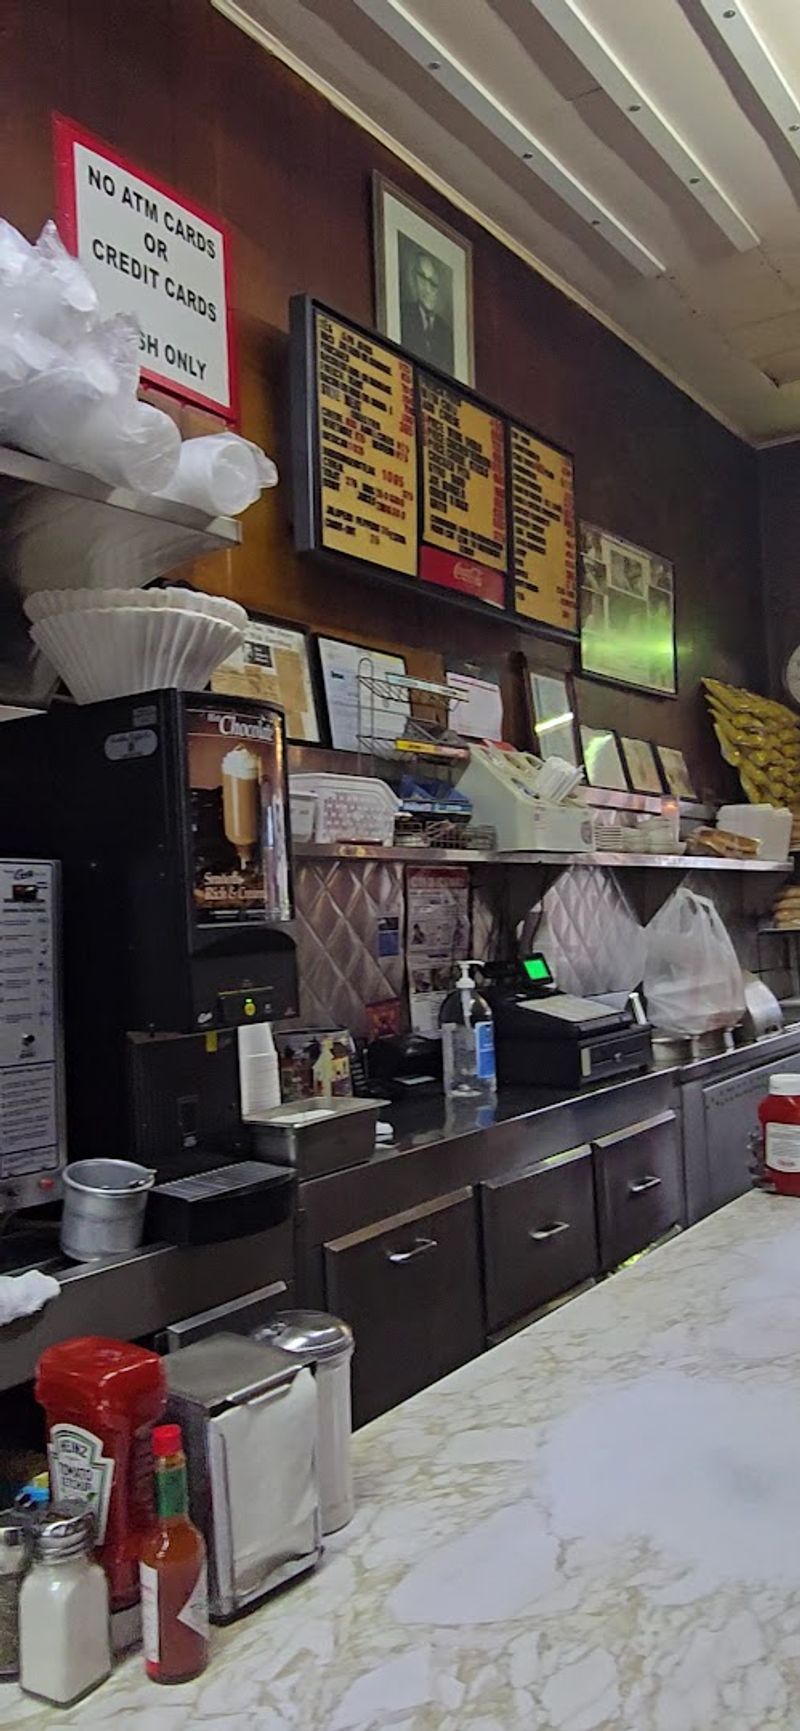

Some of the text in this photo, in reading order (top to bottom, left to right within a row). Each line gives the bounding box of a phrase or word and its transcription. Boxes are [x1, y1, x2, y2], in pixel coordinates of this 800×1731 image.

[88, 165, 216, 260] NO ATM CARDS
[144, 232, 168, 262] OR
[92, 238, 217, 323] CREDIT CARDS
[138, 330, 207, 381] SH ONLY
[60, 1440, 88, 1458] HEINZ
